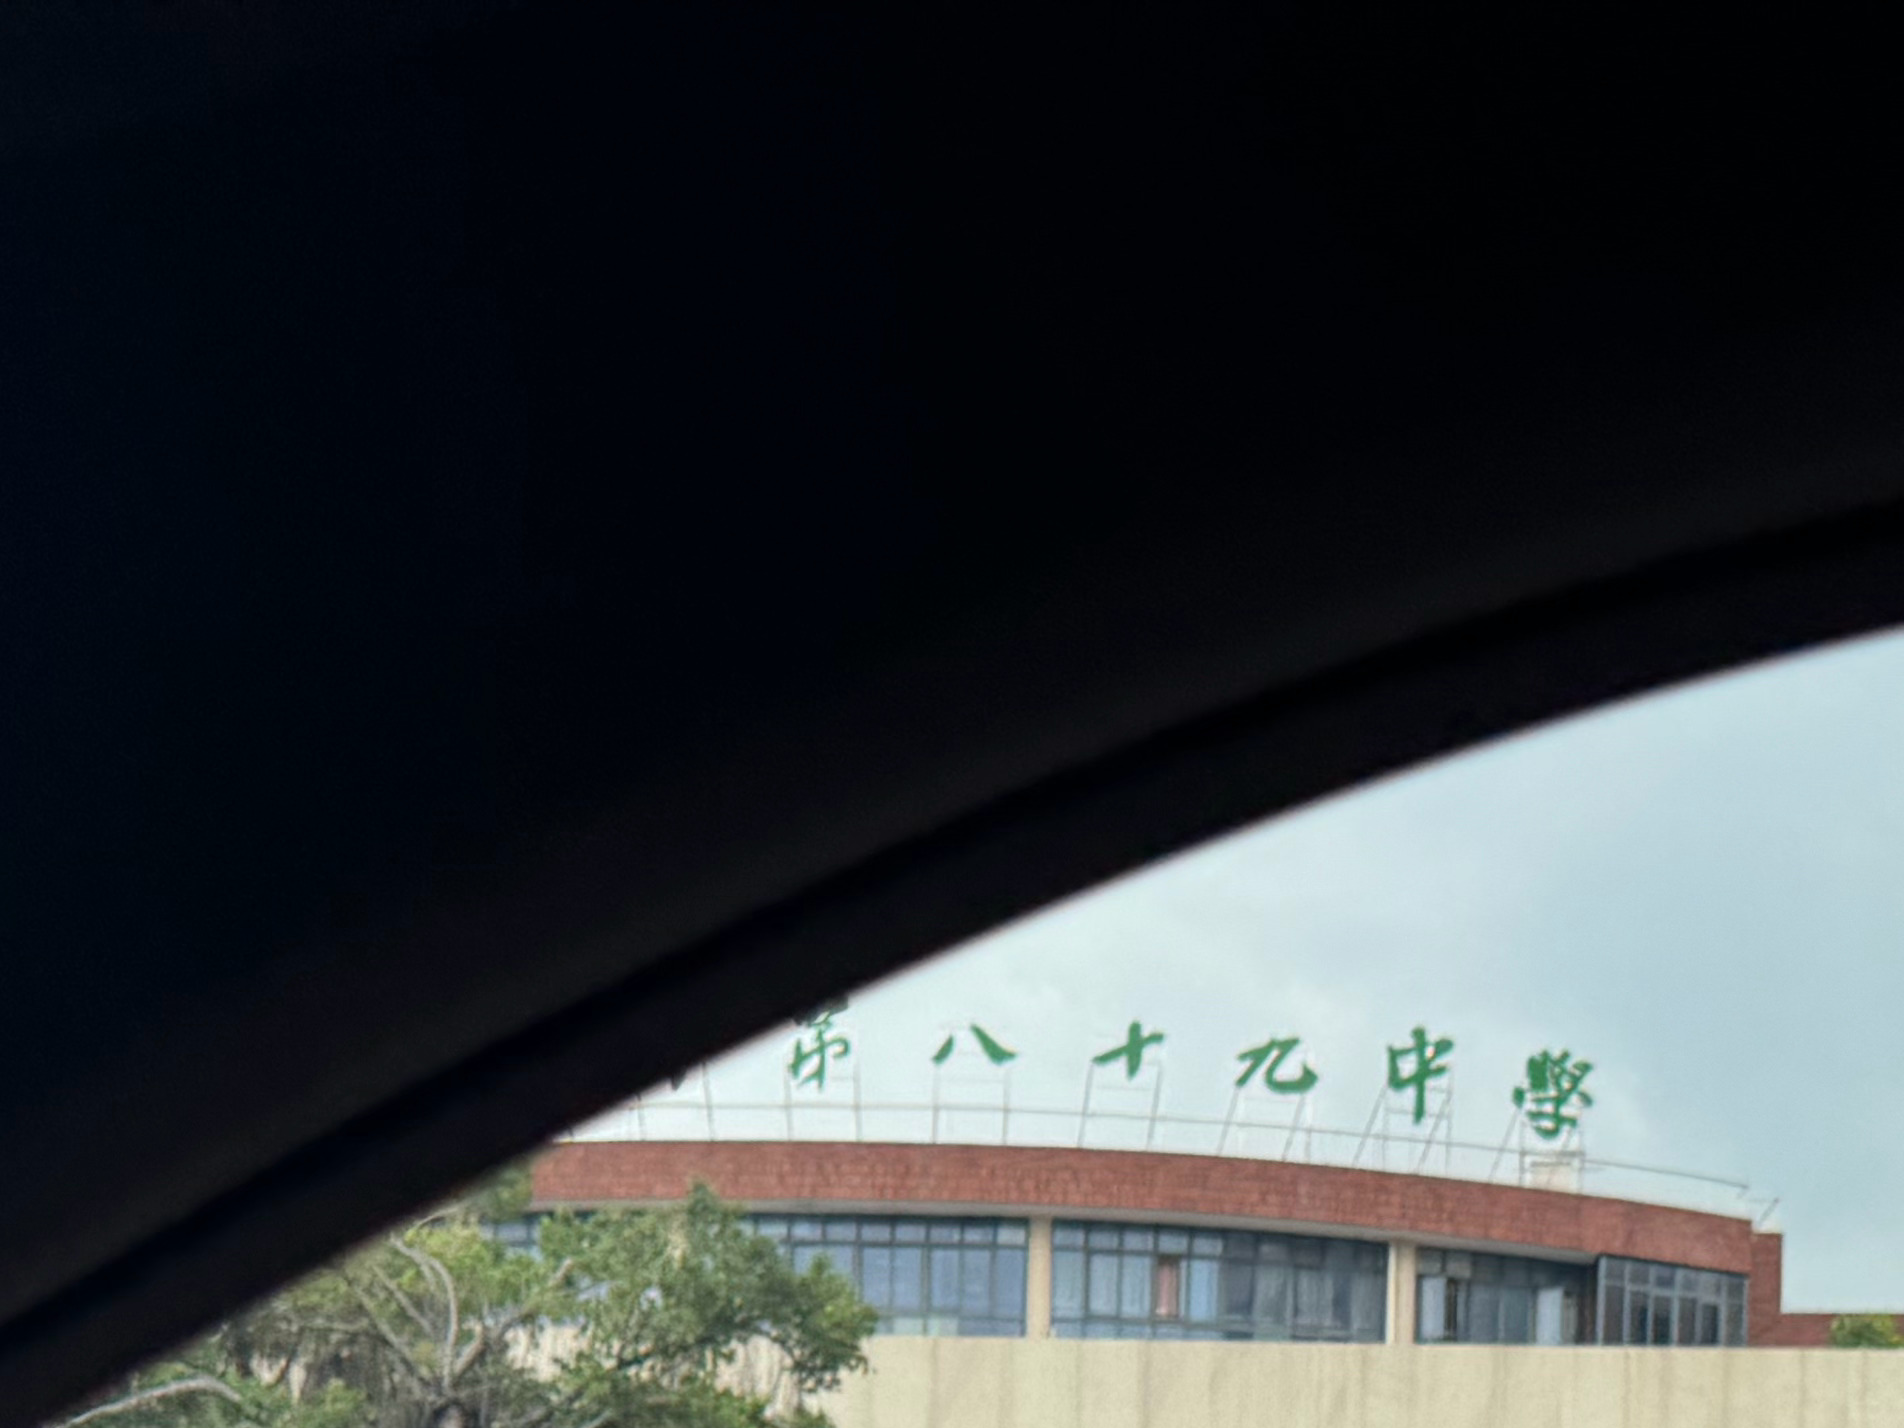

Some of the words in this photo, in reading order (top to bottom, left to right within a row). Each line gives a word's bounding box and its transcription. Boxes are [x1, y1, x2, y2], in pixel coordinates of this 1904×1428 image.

[671, 1000, 1594, 1139] 第八十九中學
